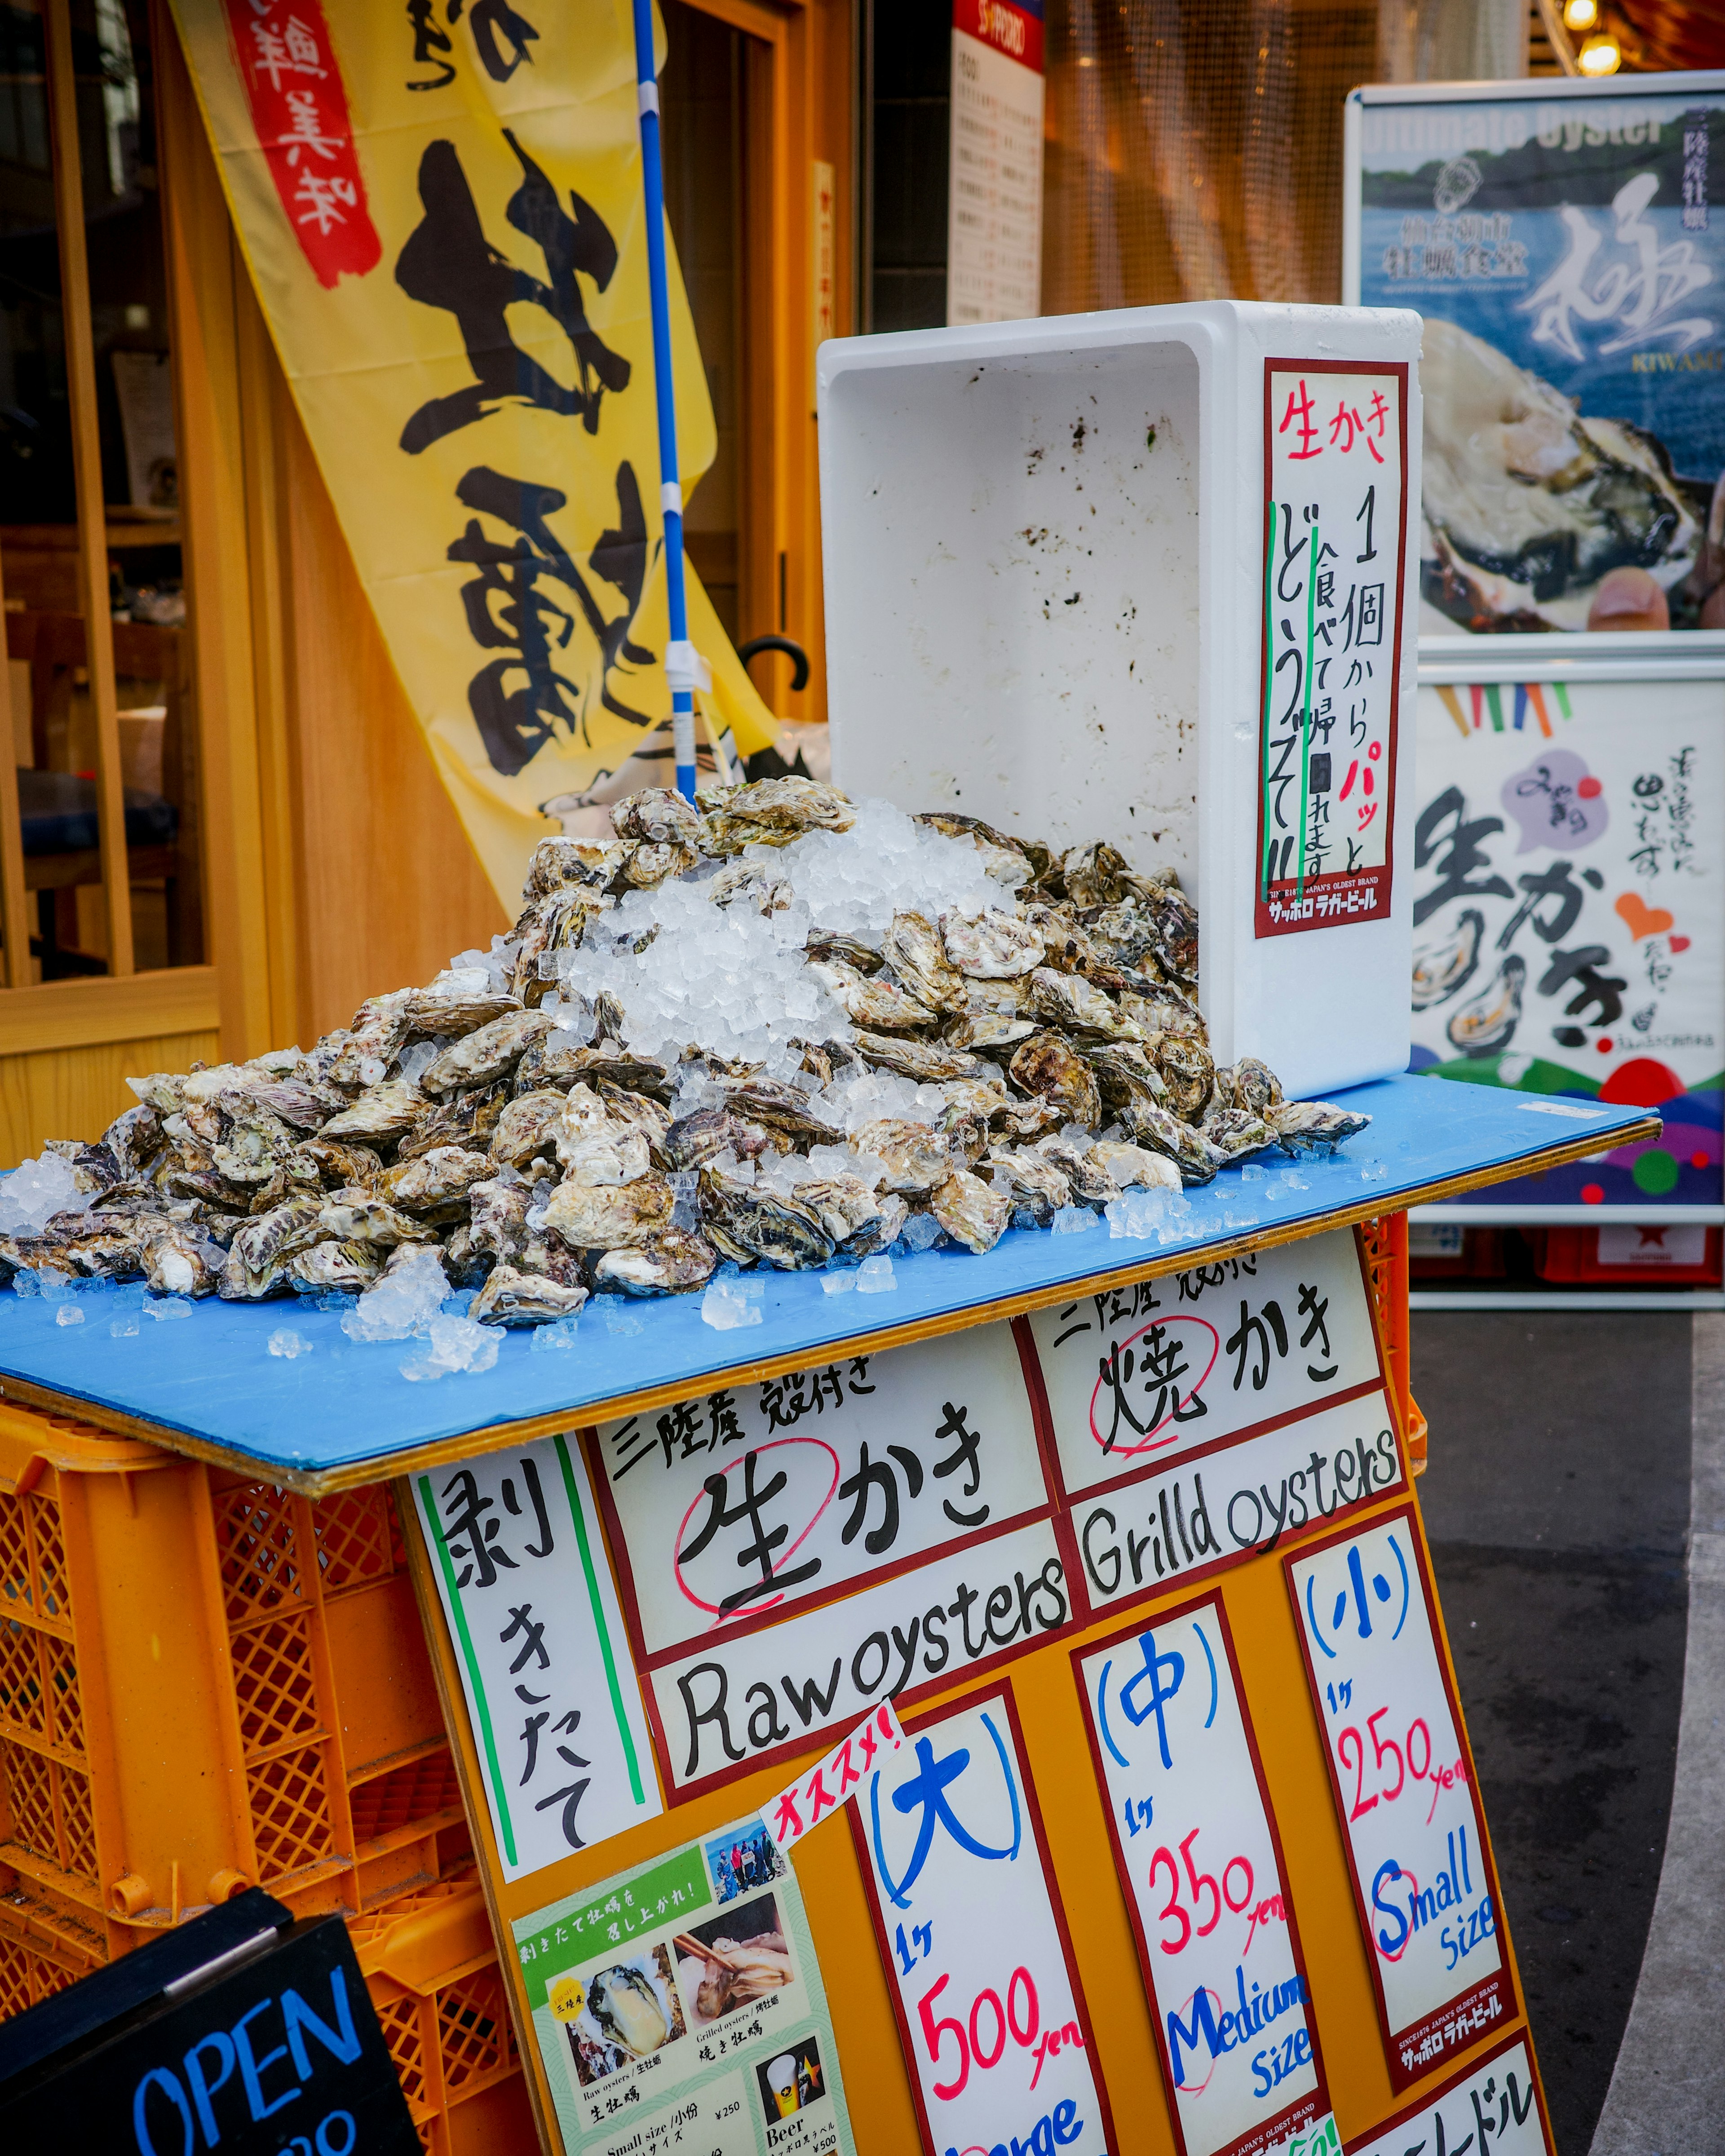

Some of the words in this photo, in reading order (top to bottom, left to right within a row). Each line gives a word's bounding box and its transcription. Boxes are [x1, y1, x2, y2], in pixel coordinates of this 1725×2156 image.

[1536, 104, 1668, 151] Oyster
[1278, 379, 1390, 464] 生かき
[1304, 543, 1339, 888] 食べて帰れます
[1269, 898, 1314, 924] サッポロ
[1315, 887, 1378, 918] ラガービール
[1306, 882, 1331, 894] JAPAN'S
[1333, 879, 1356, 890] OLDEST
[1358, 876, 1378, 886] BRAND
[1099, 1283, 1339, 1456] 焼かき
[611, 1389, 746, 1481] 三陸産
[760, 1355, 877, 1434] 殻付き
[678, 1402, 990, 1620] 生かき
[1082, 1473, 1221, 1595] Grilld
[1228, 1429, 1398, 1556] oysters
[1306, 1534, 1409, 1658] (小)
[677, 1656, 841, 1777] Raw
[851, 1557, 1068, 1701] oysters
[1097, 1623, 1217, 1770] (中)
[1337, 1705, 1431, 1823] 250
[1427, 1758, 1471, 1825] yen
[870, 1712, 1021, 1909] (大)
[1149, 1828, 1254, 1955] 350
[1242, 1892, 1289, 1957] yen
[1371, 1824, 1473, 1954] Small
[557, 1994, 584, 2014] 三陸産
[696, 2024, 723, 2044] Grilled
[724, 2013, 749, 2030] oysters
[918, 1966, 1040, 2102] 500
[1030, 2020, 1086, 2092] yen
[1167, 1964, 1310, 2088] Medium
[1398, 2025, 1430, 2050] SINCE1876
[1431, 2009, 1455, 2029] JAPAN'S
[1455, 1995, 1477, 2013] OLDEST
[1478, 1982, 1499, 1999] BRAND
[1401, 2031, 1444, 2072] サッポロ
[1444, 1993, 1503, 2045] ラガービール
[133, 1964, 363, 2156] OPEN
[583, 2088, 601, 2102] Raw
[602, 2074, 630, 2093] oysters
[636, 2054, 662, 2076] 生牡蛎
[590, 2085, 641, 2125] 生牡蠣
[607, 2134, 642, 2156] Small
[645, 2123, 668, 2142] size
[636, 2128, 683, 2156] サイズ
[715, 2101, 740, 2121] ¥250
[765, 2118, 804, 2149] Beer
[812, 2134, 836, 2153] ¥500
[1238, 2134, 1264, 2156] JAPAN'S
[1265, 2118, 1291, 2139] OLDEST
[1292, 2103, 1315, 2122] BRAND
